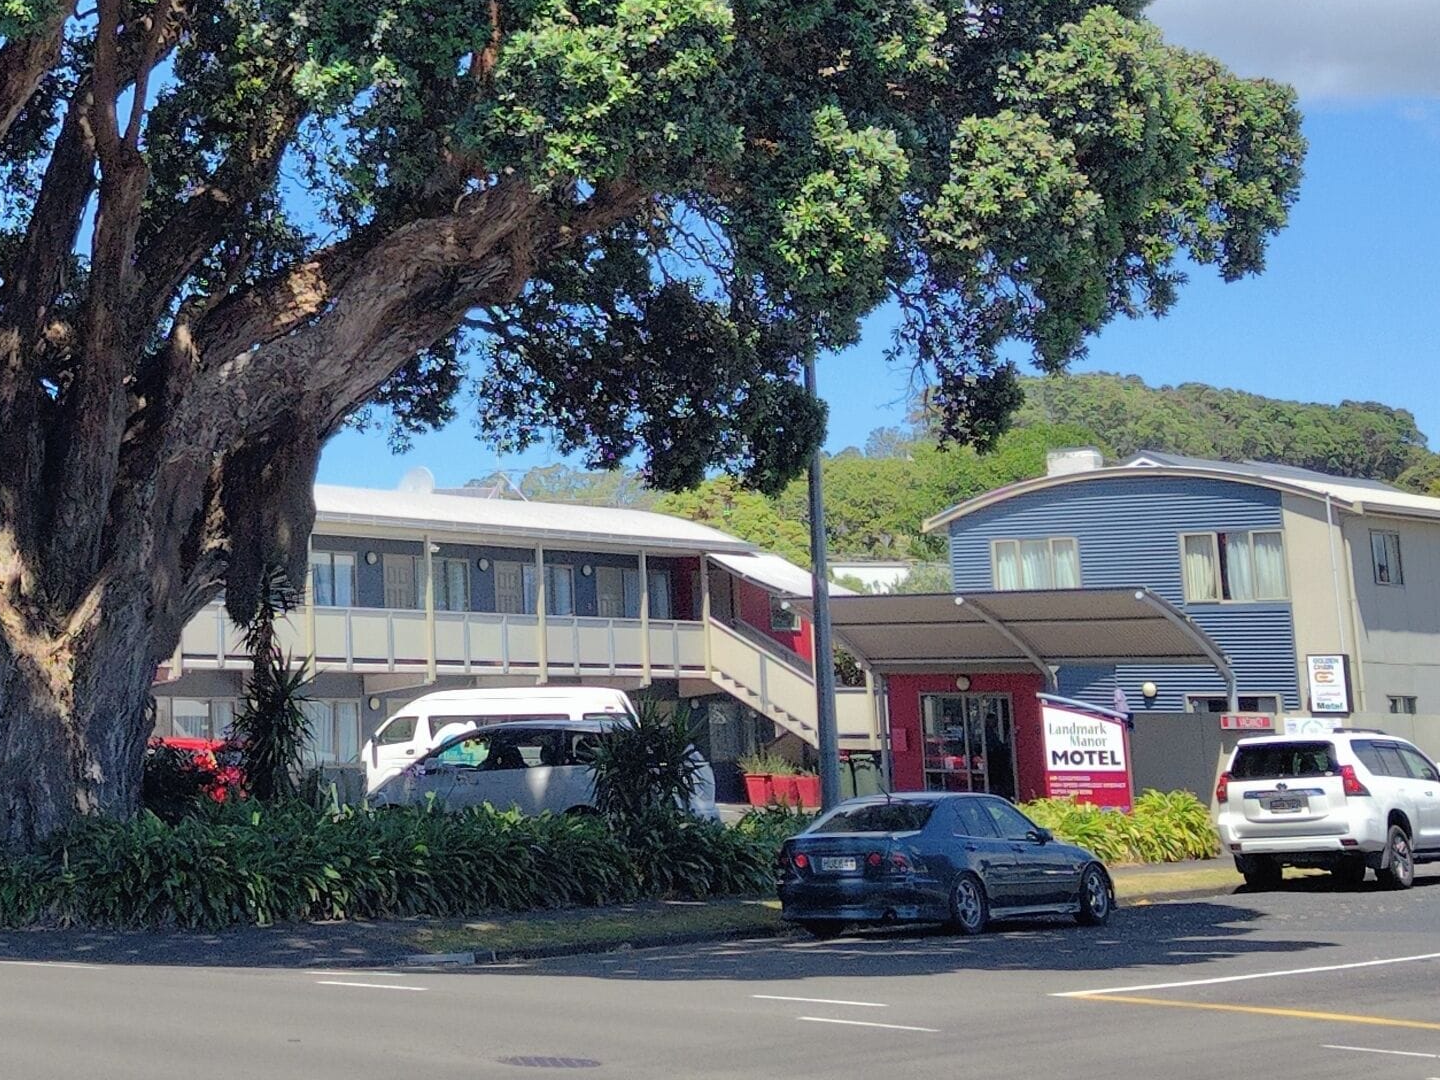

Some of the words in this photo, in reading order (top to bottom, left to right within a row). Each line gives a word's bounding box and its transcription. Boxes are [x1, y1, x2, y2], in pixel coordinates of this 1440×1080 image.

[1049, 722, 1107, 735] Landmark
[1070, 735, 1107, 747] Manor
[1051, 750, 1122, 766] MOTEL
